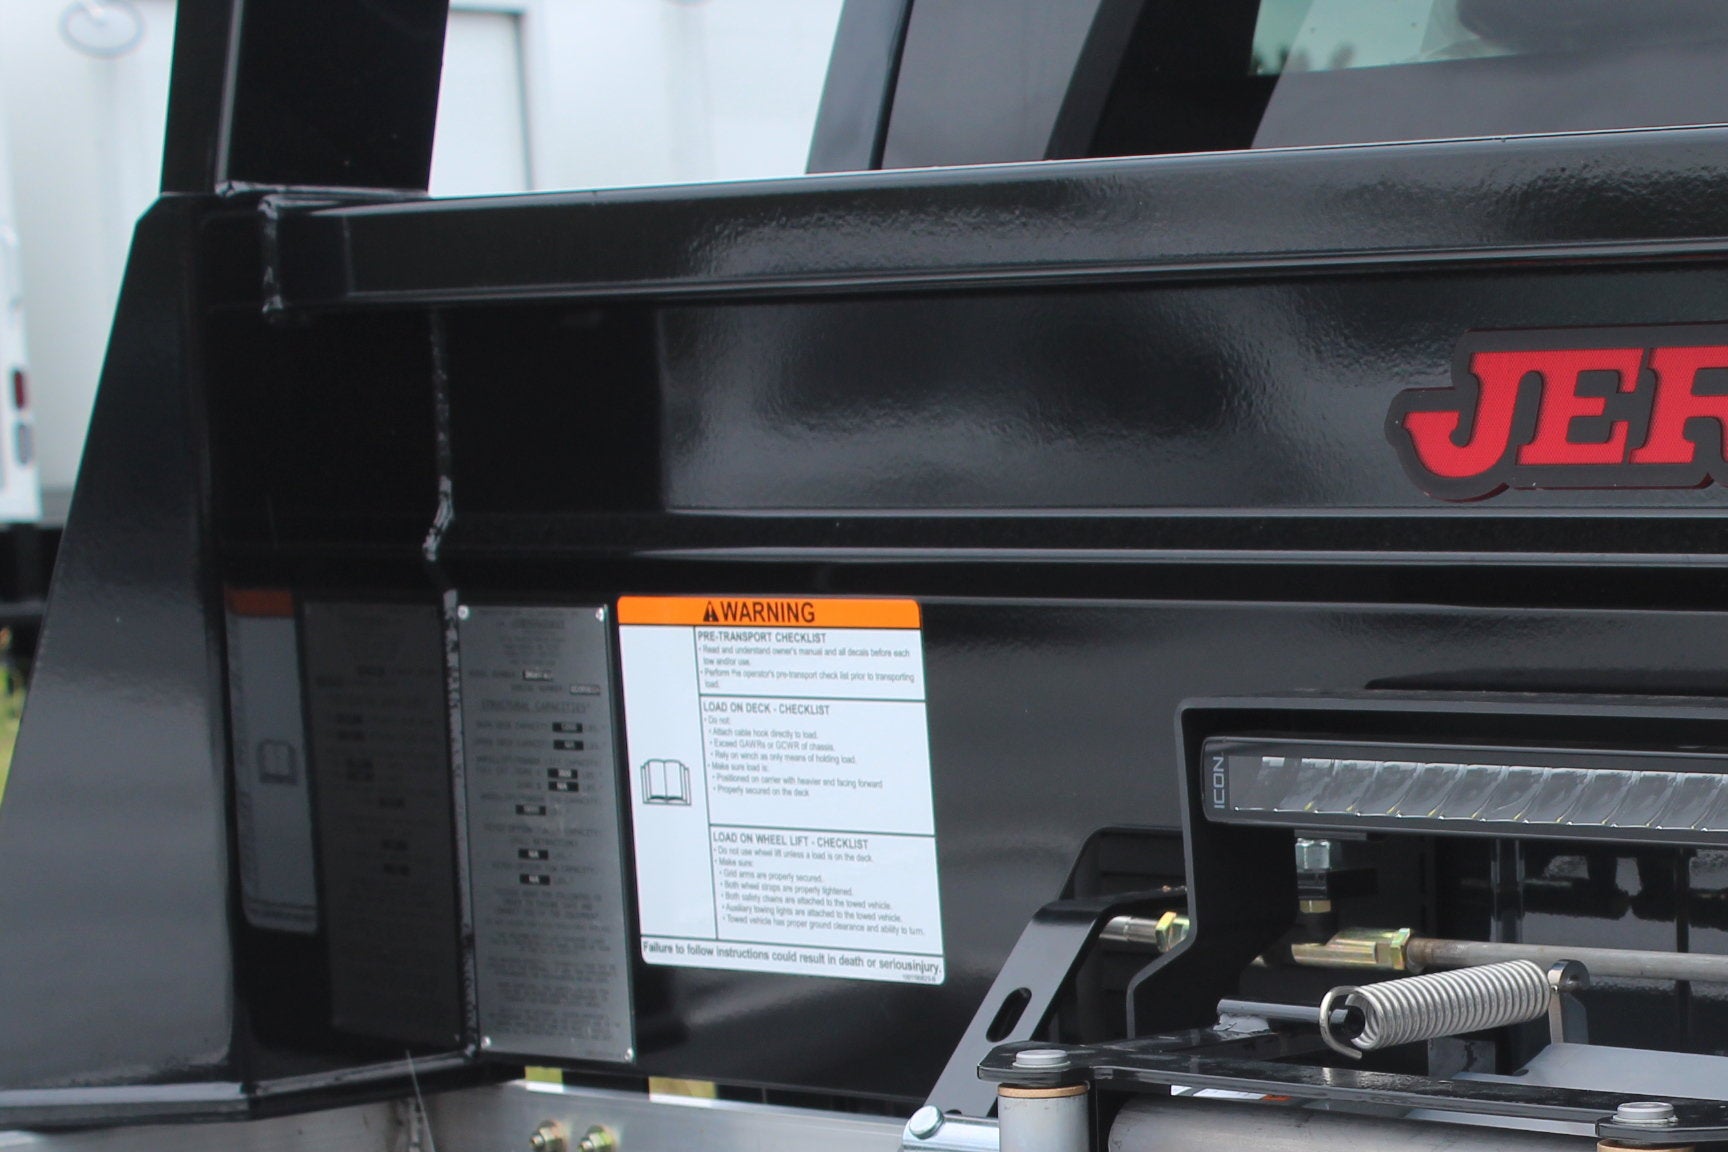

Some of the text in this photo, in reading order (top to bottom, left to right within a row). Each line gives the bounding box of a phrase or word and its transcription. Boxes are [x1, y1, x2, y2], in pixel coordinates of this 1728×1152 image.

[721, 601, 815, 624] WARNING
[698, 631, 826, 643] PRE-TRANSPORT CHECKLIST
[703, 703, 830, 714] LOAD ON DECK CHECKLIST
[1212, 756, 1225, 809] ICON
[713, 833, 868, 849] LOAD ON WHEEL LIFT CHECKLIST
[643, 941, 673, 953] Failure
[675, 943, 685, 954] to
[686, 944, 714, 956] follow
[715, 946, 769, 960] instructions
[771, 950, 797, 962] could
[798, 952, 825, 964] result
[827, 954, 836, 965] in
[838, 955, 864, 967] death
[866, 958, 877, 968] or
